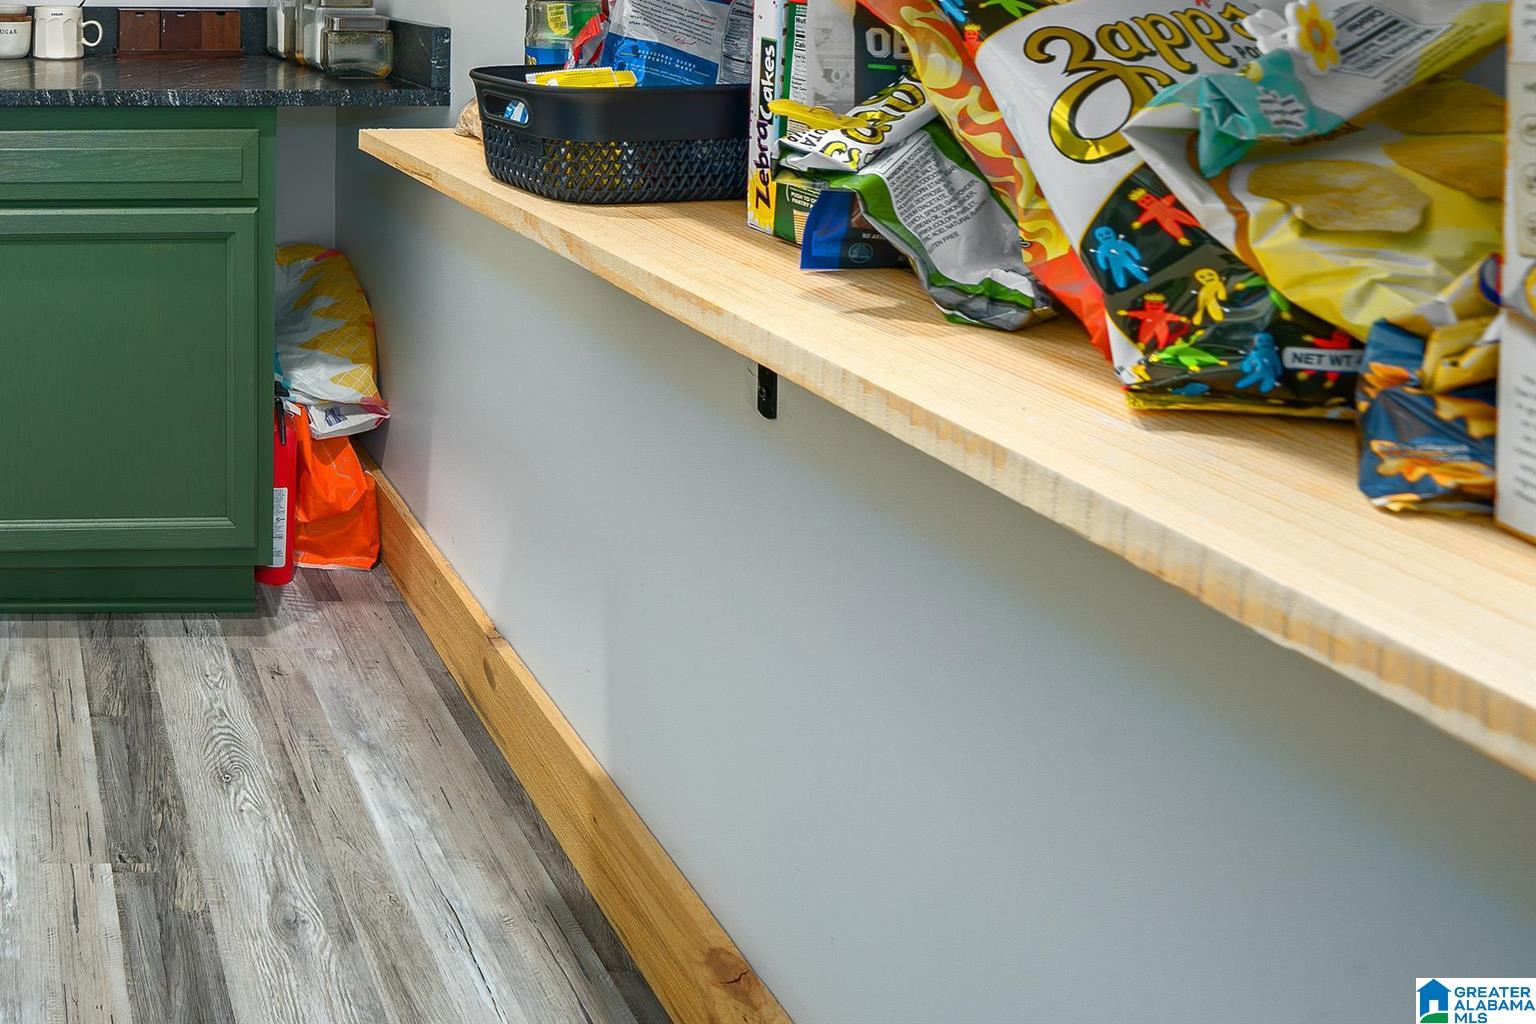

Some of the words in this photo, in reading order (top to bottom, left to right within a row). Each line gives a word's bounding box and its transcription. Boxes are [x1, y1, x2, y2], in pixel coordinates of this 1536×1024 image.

[760, 43, 777, 118] Cakes
[754, 117, 774, 210] Zebra
[1292, 353, 1325, 366] NET
[1328, 353, 1353, 366] WT
